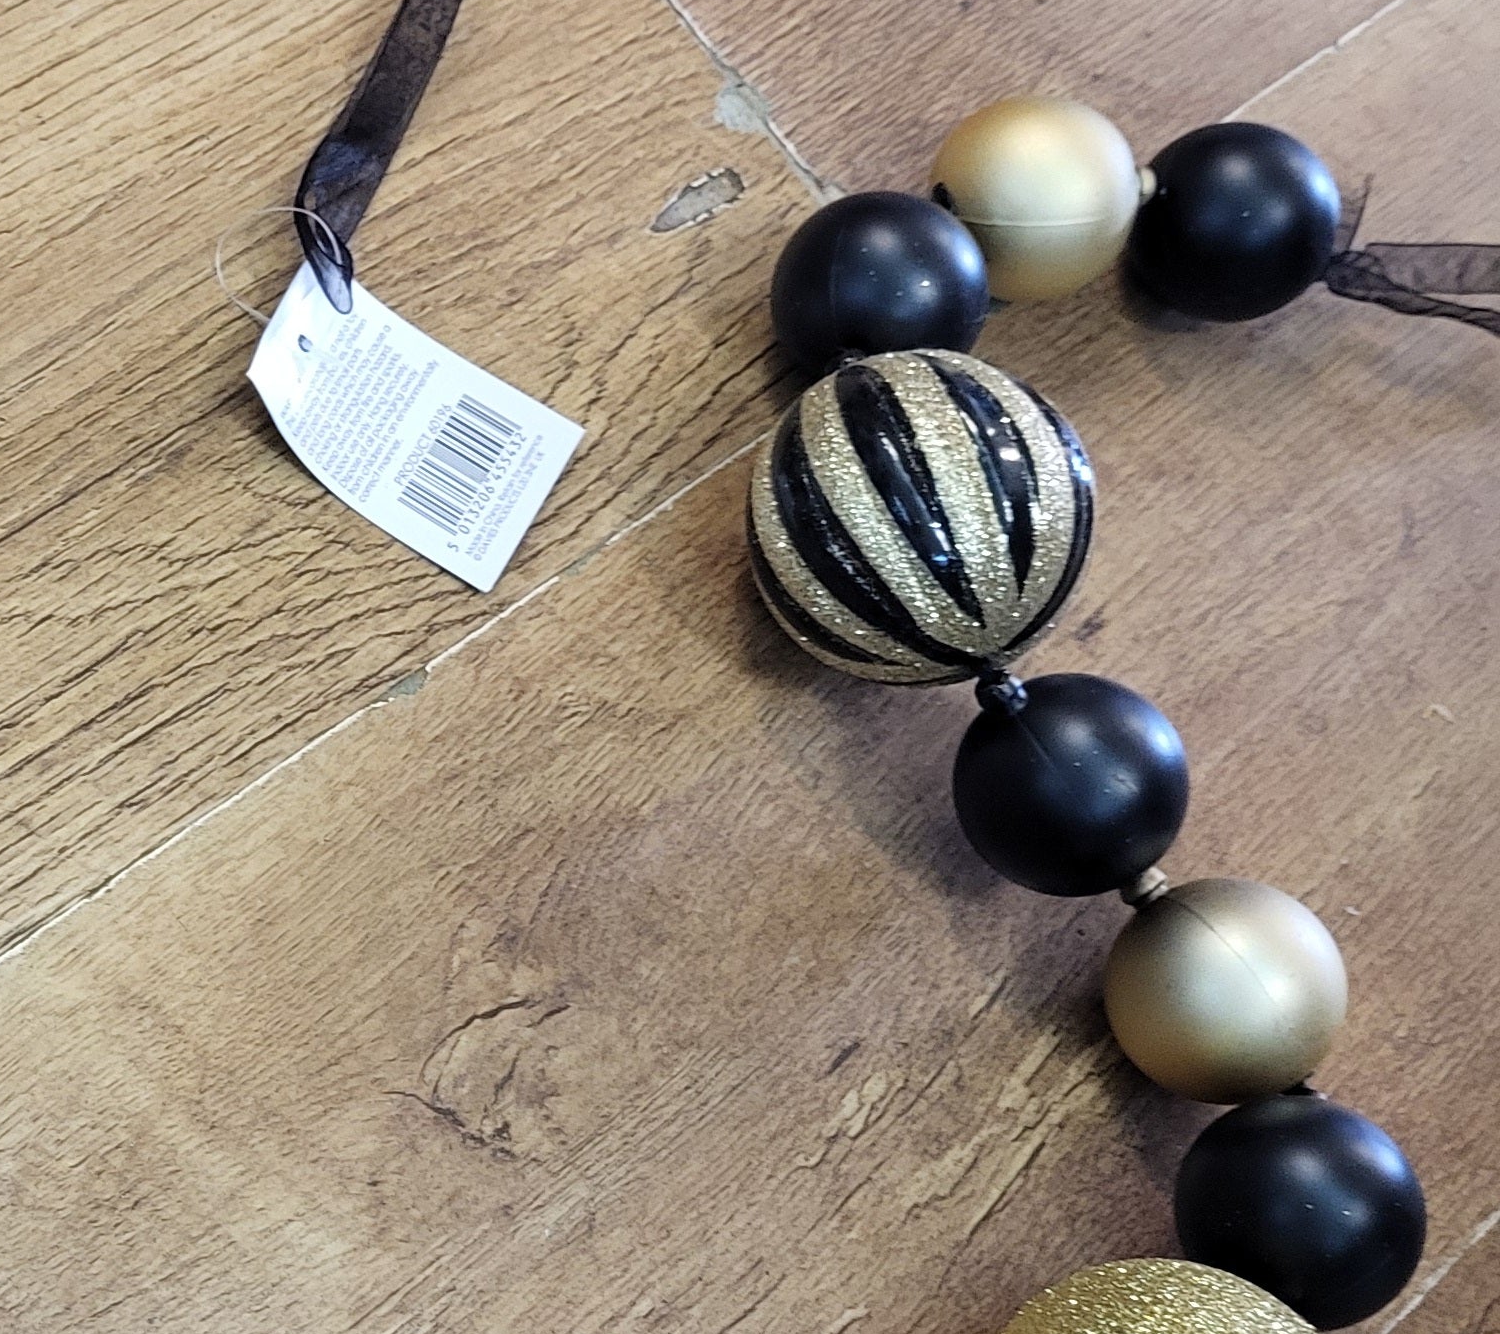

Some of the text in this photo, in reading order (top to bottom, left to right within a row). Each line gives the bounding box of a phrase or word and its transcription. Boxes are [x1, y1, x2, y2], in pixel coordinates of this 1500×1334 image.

[336, 428, 353, 450] away
[370, 376, 385, 395] and
[371, 392, 404, 438] packaging
[399, 368, 418, 392] away
[314, 431, 338, 464] choking
[346, 475, 364, 495] from
[361, 442, 385, 475] children
[393, 403, 451, 486] PRODUCT 60196
[358, 470, 380, 502] correct
[457, 484, 495, 534] 013206
[491, 432, 526, 480] 455432
